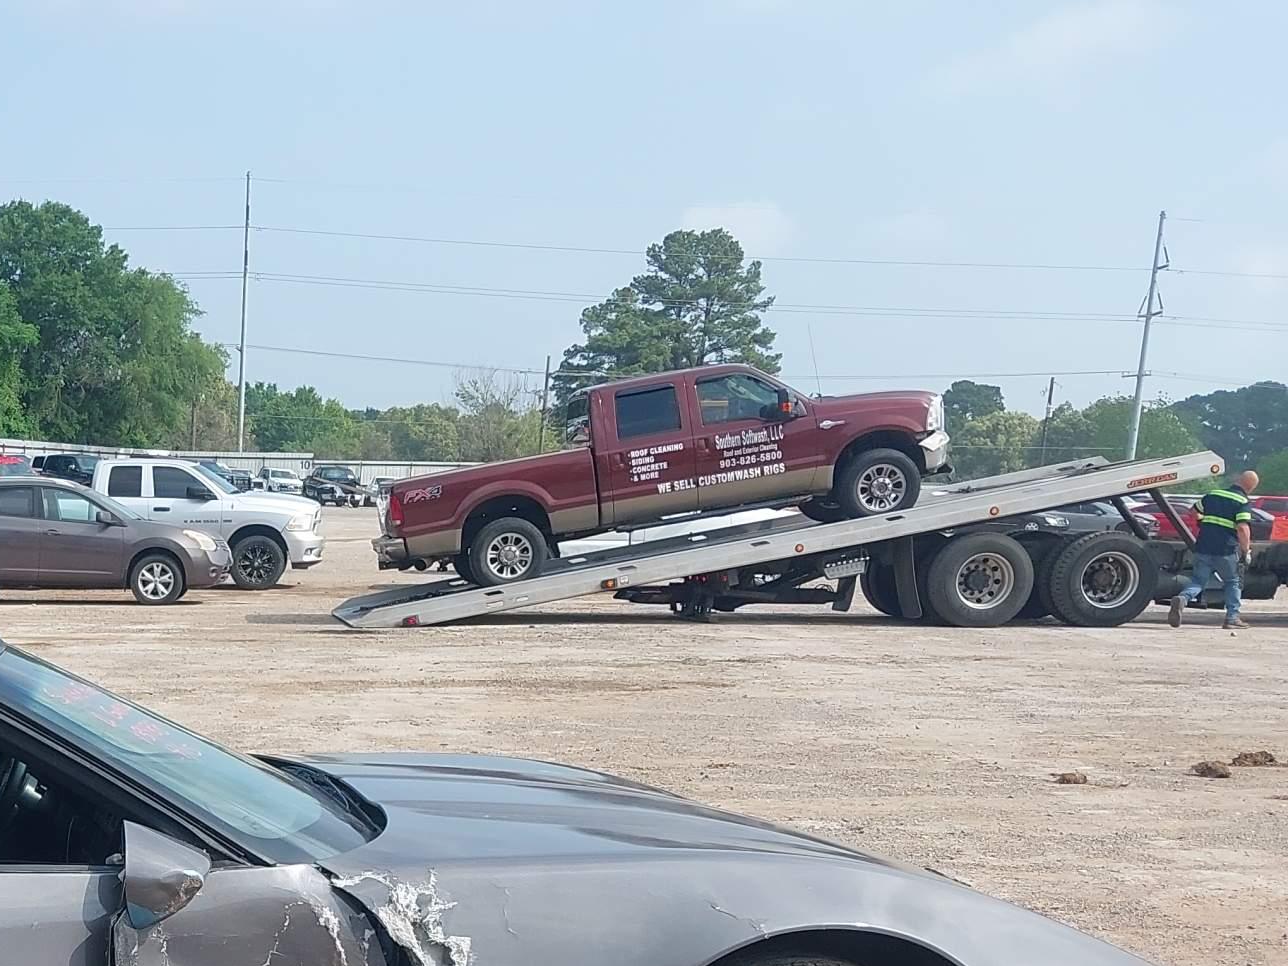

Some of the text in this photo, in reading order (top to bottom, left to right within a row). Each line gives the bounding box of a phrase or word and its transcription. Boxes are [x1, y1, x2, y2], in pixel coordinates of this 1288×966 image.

[715, 432, 741, 450] Southern
[771, 425, 784, 440] LLC
[649, 442, 684, 454] CLEANING
[734, 448, 743, 457] and
[743, 446, 759, 455] Exterior
[759, 443, 778, 454] Cleaning
[300, 460, 311, 470] 10
[631, 456, 655, 466] SIDING
[719, 450, 783, 469] 903-826-5800
[632, 462, 668, 474] CONCRETE
[640, 471, 660, 481] MORE
[657, 482, 672, 494] WE
[673, 478, 697, 492] SELL
[763, 462, 786, 476] RIGS
[404, 485, 441, 503] FX4
